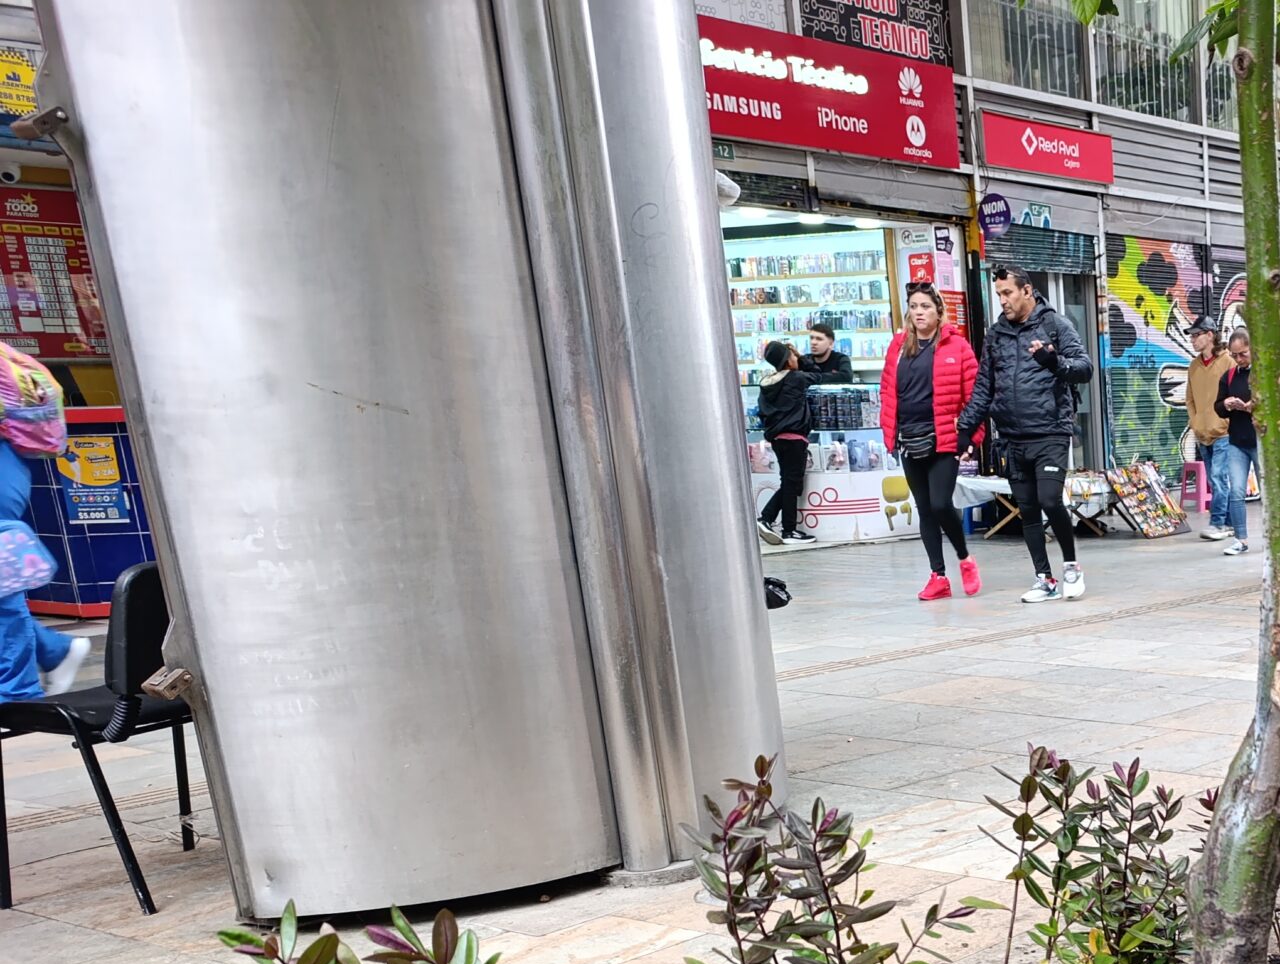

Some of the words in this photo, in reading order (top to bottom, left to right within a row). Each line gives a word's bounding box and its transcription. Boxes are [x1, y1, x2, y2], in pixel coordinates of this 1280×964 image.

[858, 13, 930, 60] TECNICO
[817, 107, 868, 134] iPhone
[899, 96, 925, 108] HUAWEI
[903, 146, 933, 159] motorola
[1038, 137, 1058, 154] Red
[1058, 140, 1080, 158] Aval
[5, 202, 39, 213] TODO
[982, 199, 1007, 216] WOM
[78, 511, 106, 520] $5.000
